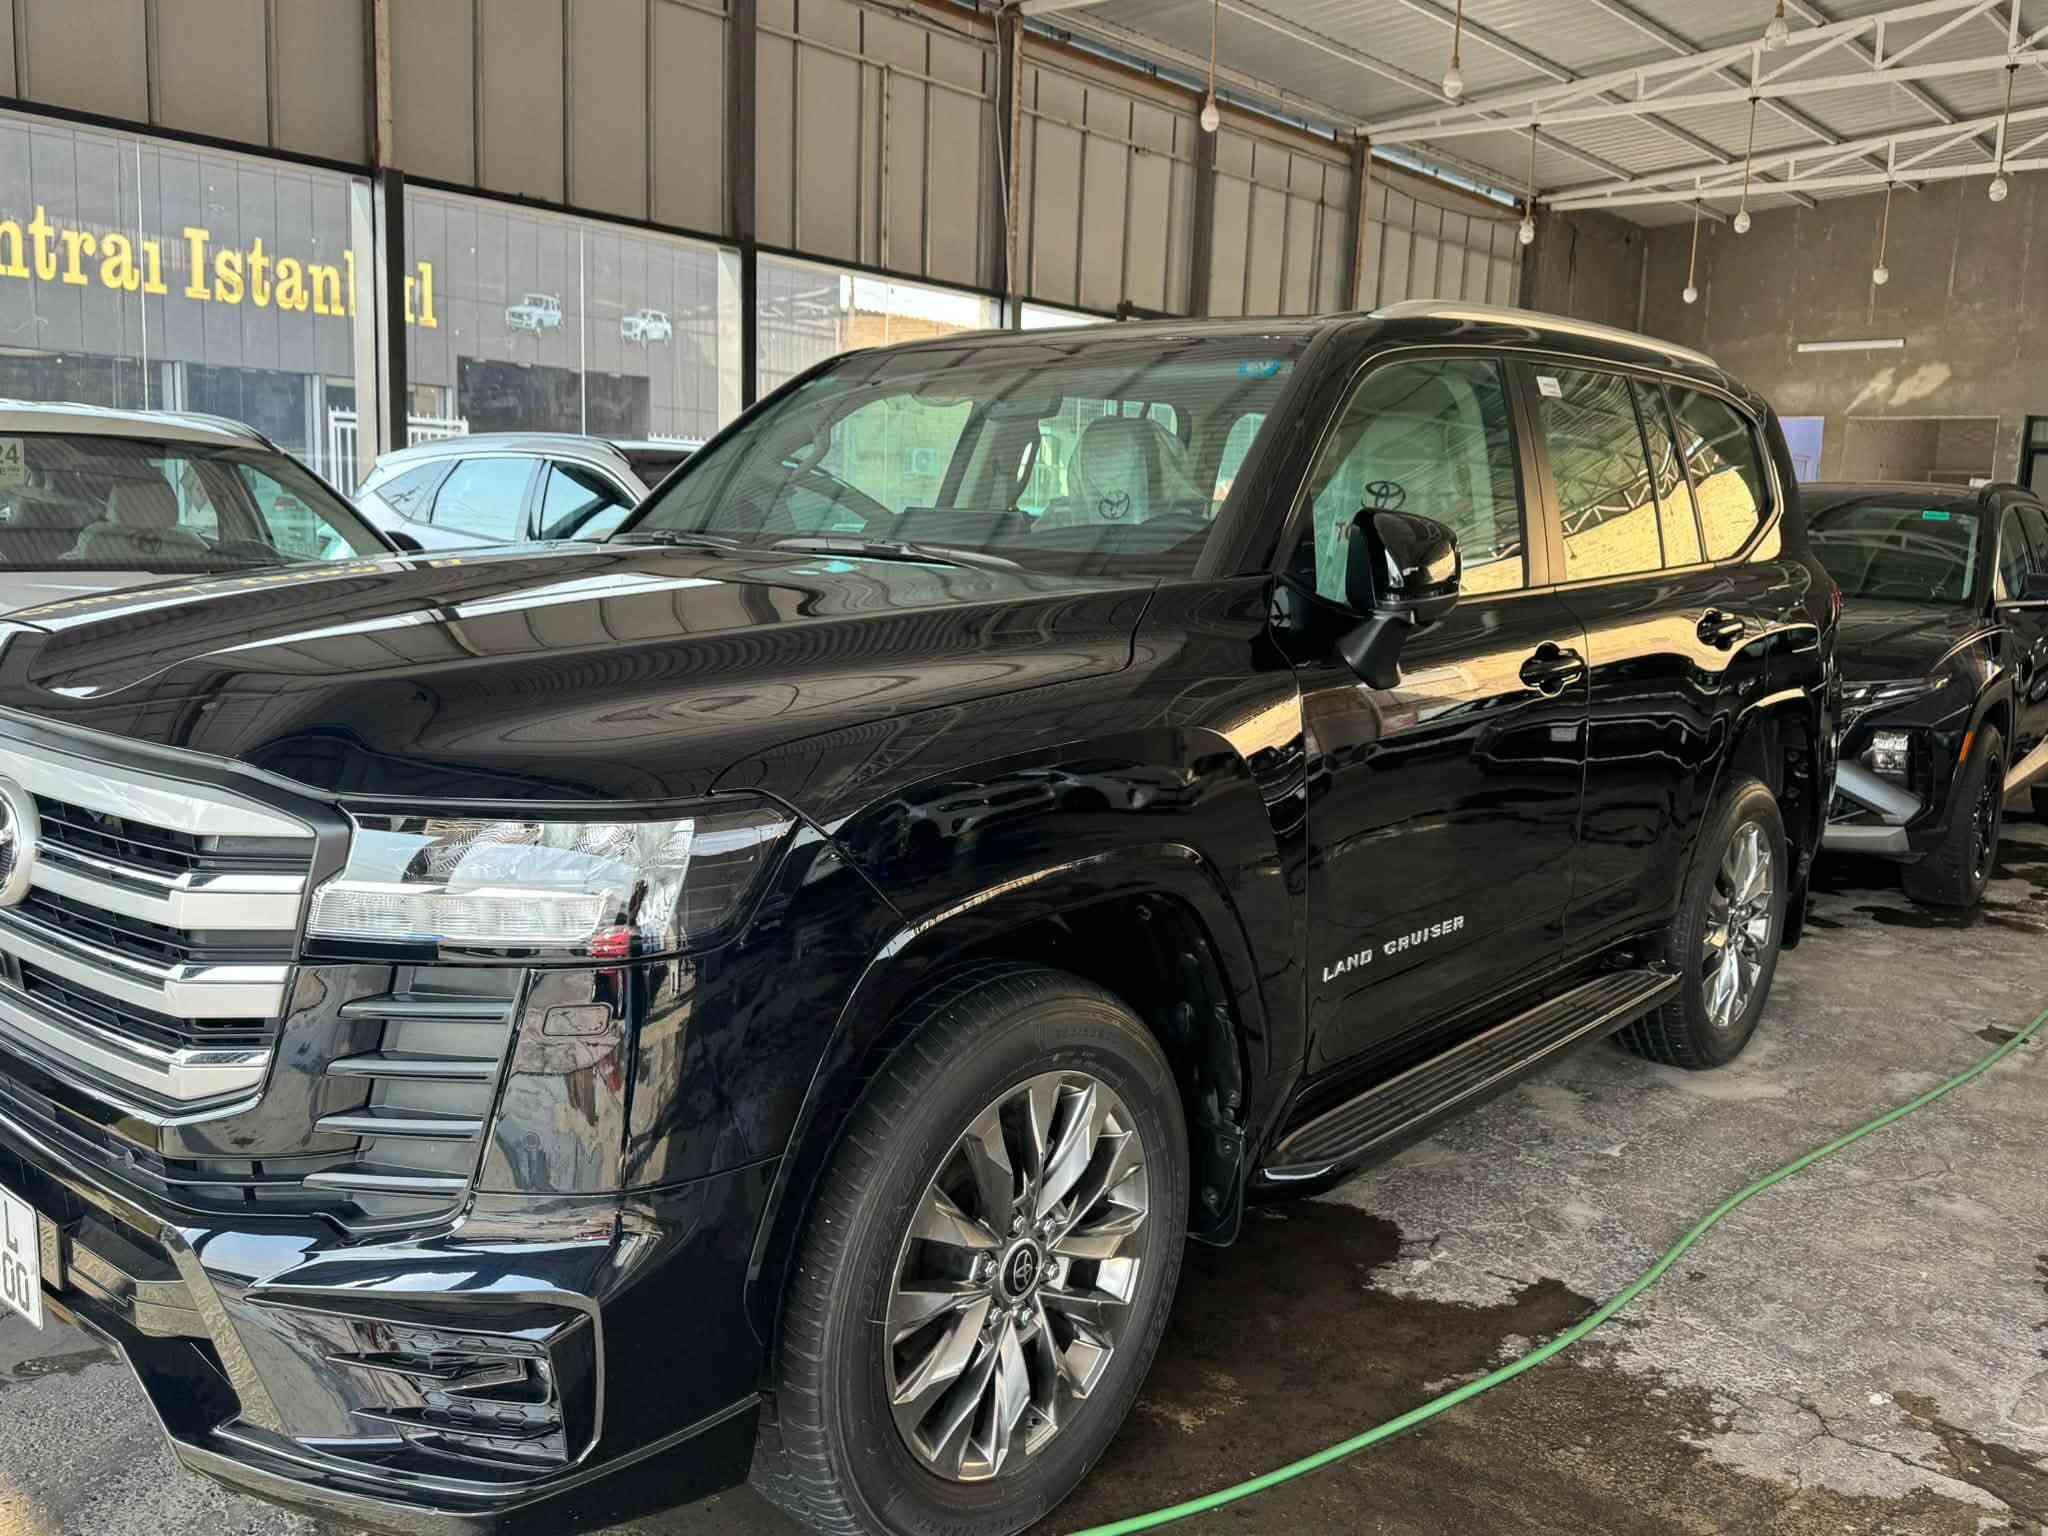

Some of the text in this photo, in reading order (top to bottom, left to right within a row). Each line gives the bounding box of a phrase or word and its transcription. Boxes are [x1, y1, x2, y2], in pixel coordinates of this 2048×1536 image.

[183, 226, 437, 328] Istanl
[1322, 915, 1464, 983] LAND CRUISER
